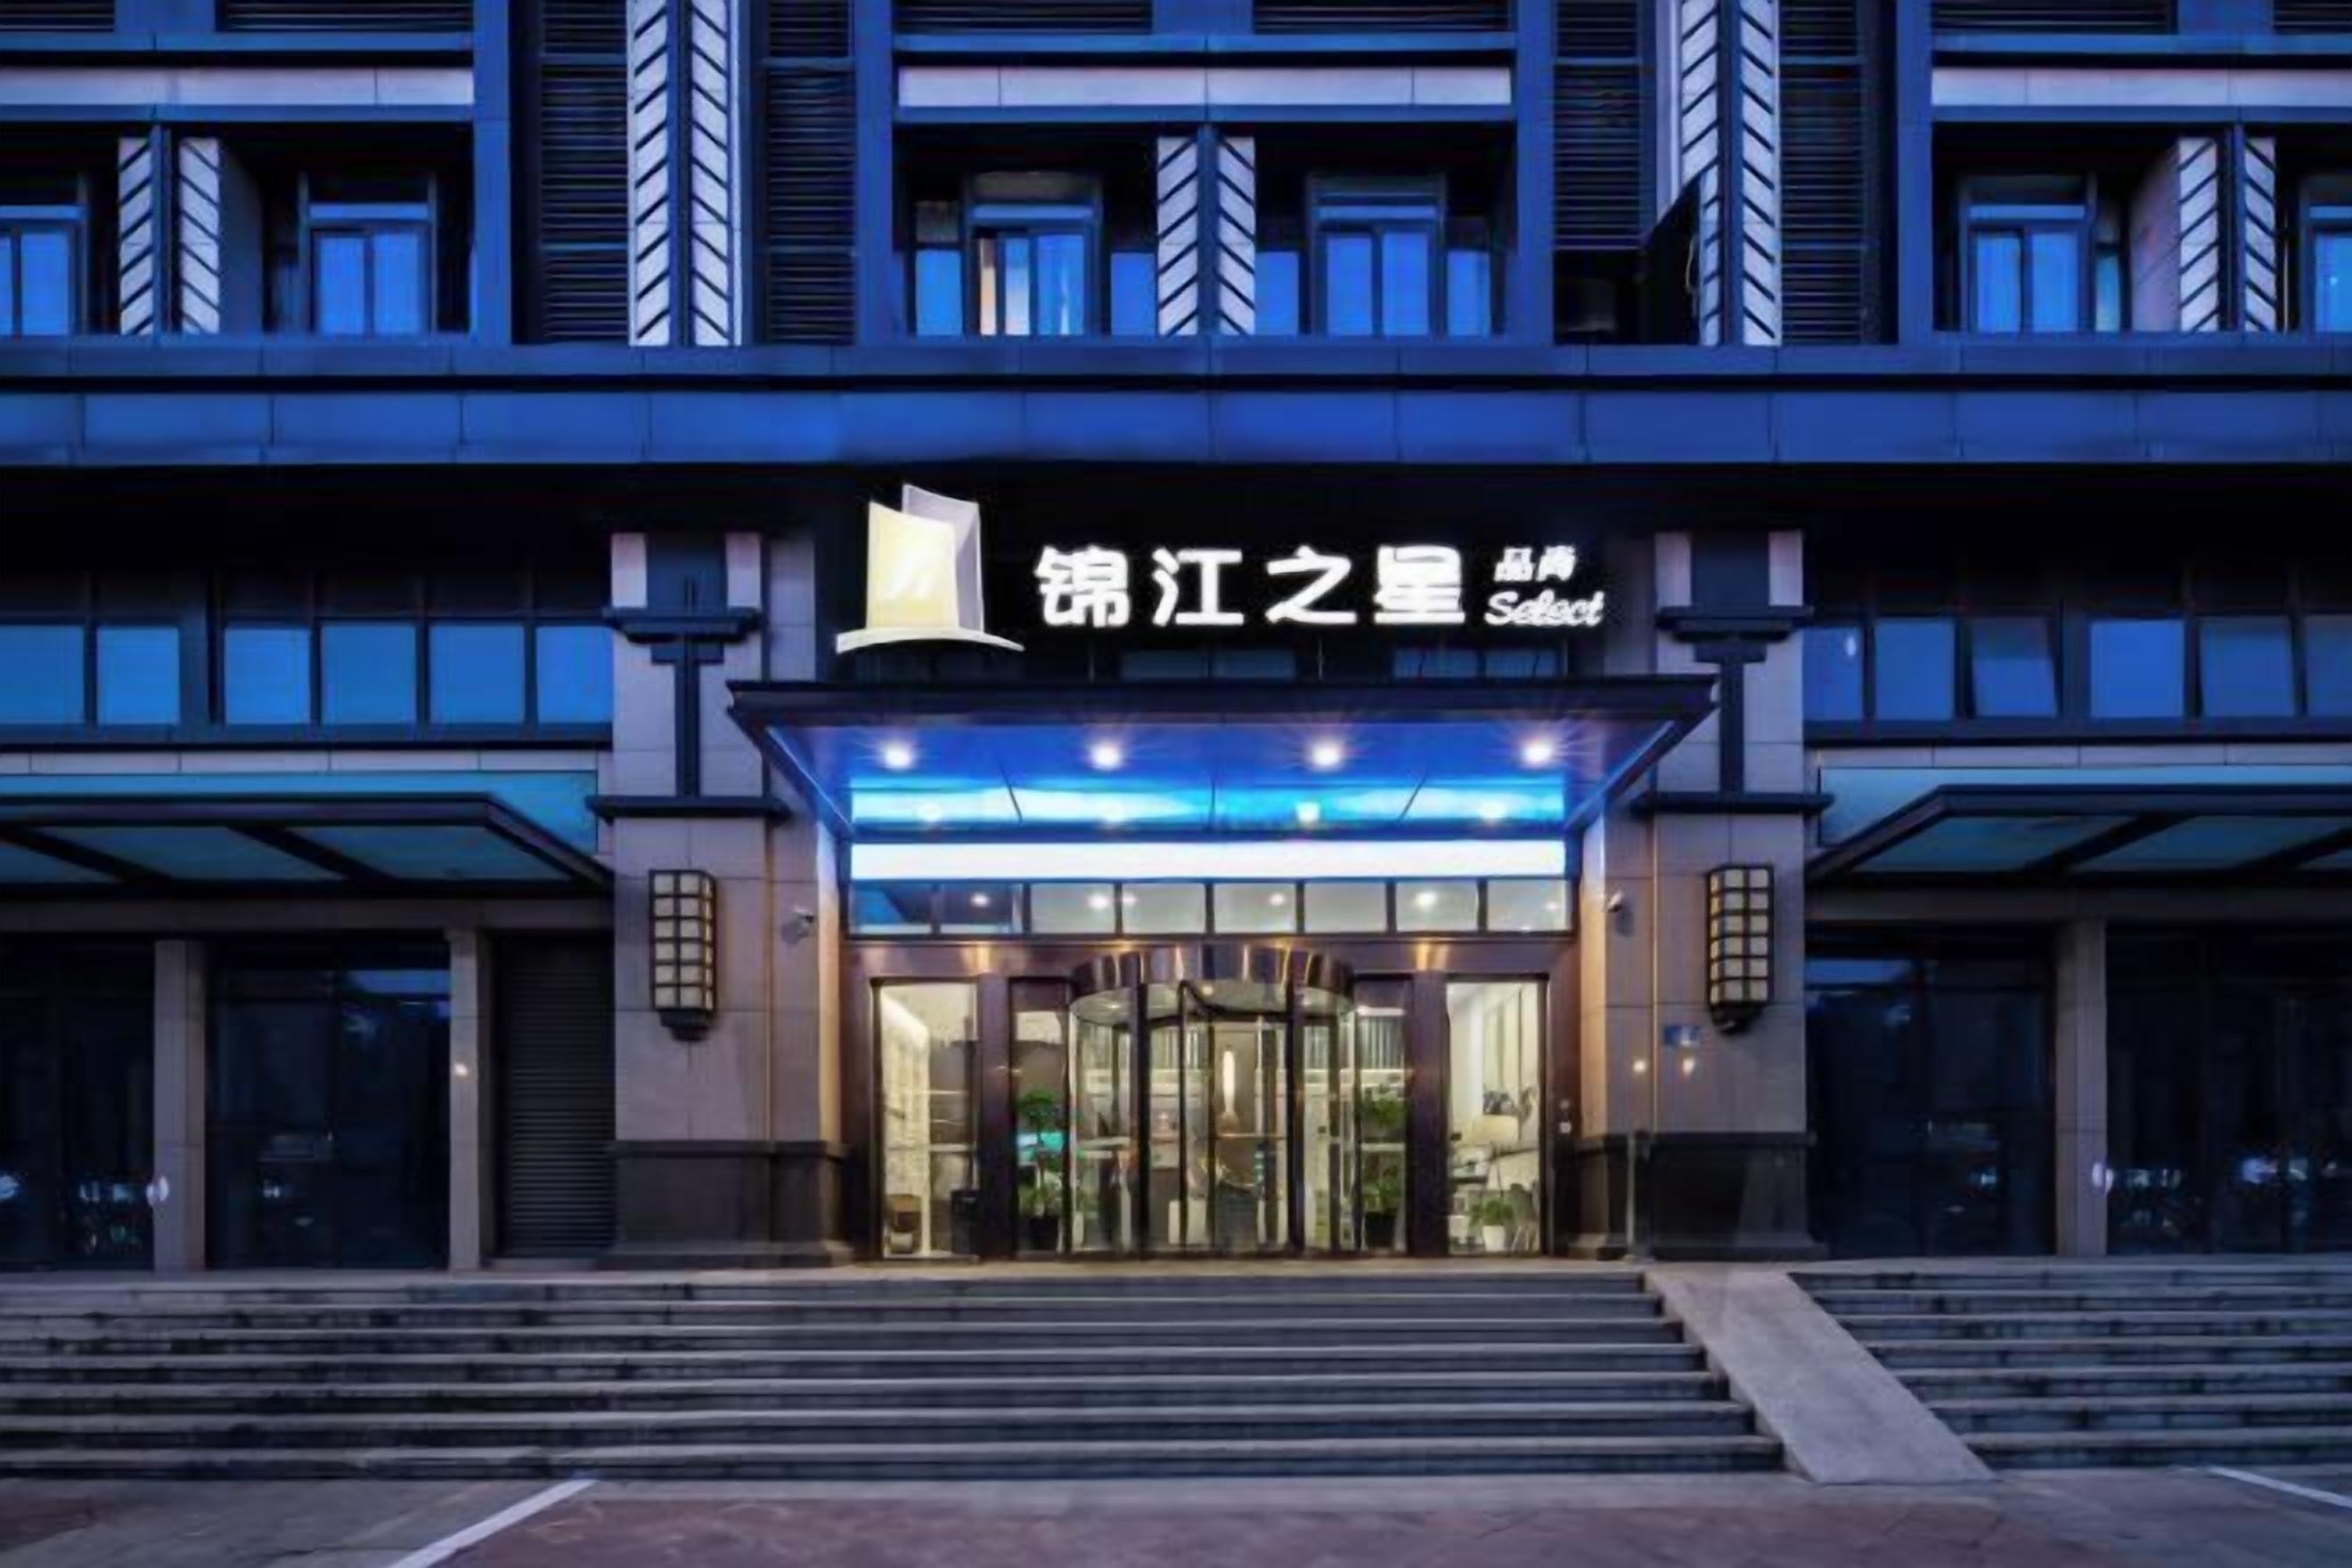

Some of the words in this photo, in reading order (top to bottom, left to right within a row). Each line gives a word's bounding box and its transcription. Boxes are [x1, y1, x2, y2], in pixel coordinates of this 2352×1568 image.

[1033, 544, 1466, 628] 锦江之星
[1483, 588, 1605, 627] Select
